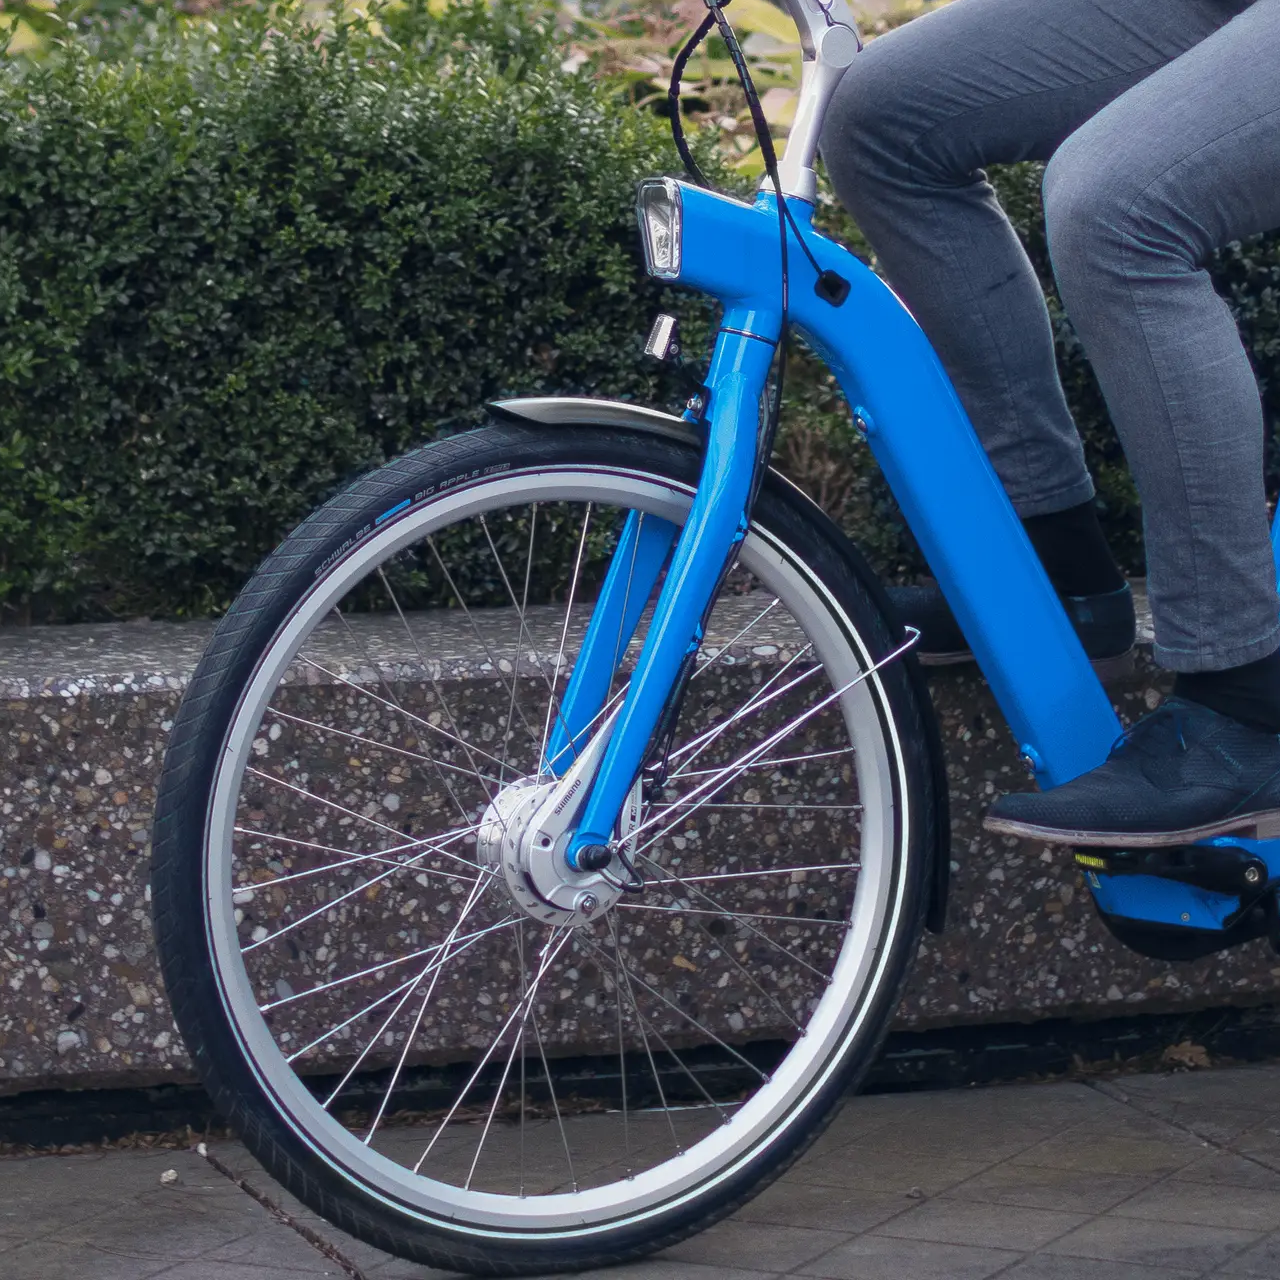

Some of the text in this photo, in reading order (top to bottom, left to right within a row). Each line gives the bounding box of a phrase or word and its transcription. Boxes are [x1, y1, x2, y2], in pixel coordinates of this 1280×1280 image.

[314, 469, 480, 577] SCHWALBE BIG APPLE
[554, 778, 582, 816] SHIMANO
